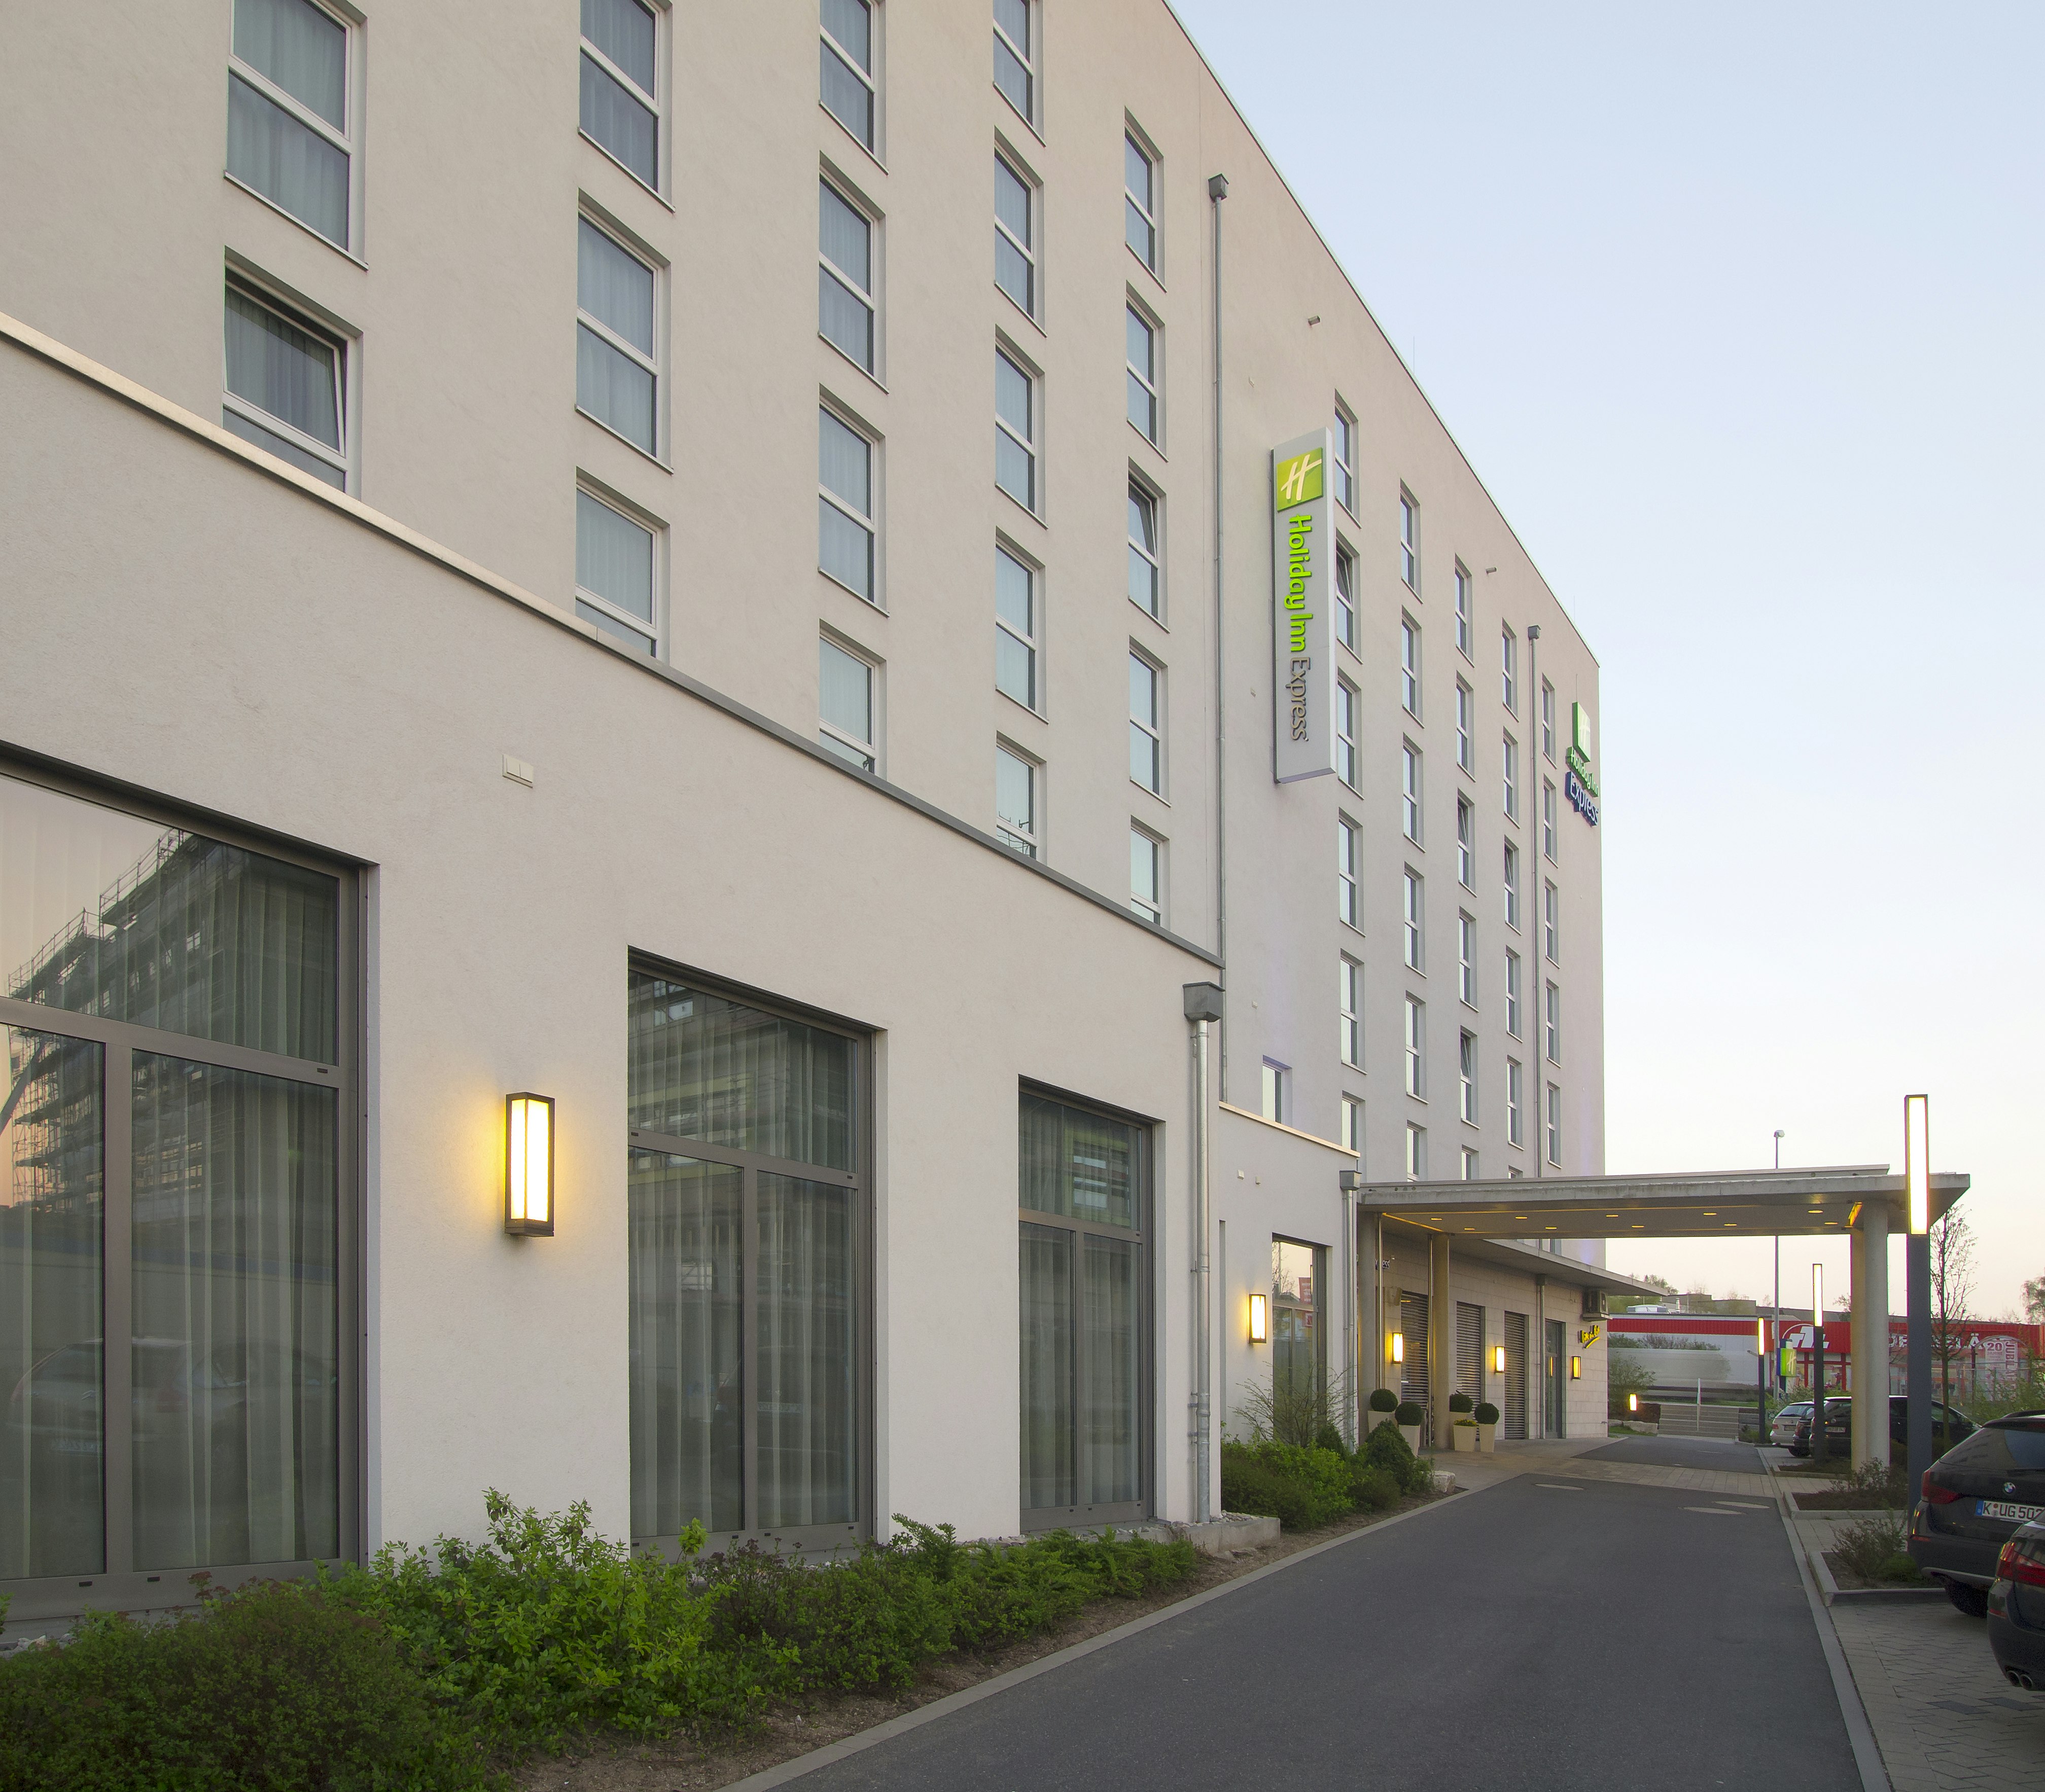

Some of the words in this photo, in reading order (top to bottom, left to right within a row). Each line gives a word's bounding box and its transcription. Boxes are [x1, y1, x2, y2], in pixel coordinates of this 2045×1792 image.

[1284, 514, 1312, 612] Holiday
[1289, 613, 1313, 652] Inn
[1285, 657, 1311, 742] Express
[1570, 771, 1599, 825] Express
[1987, 1342, 2003, 1351] 20
[1983, 1502, 1992, 1515] K
[1999, 1504, 2016, 1518] UG
